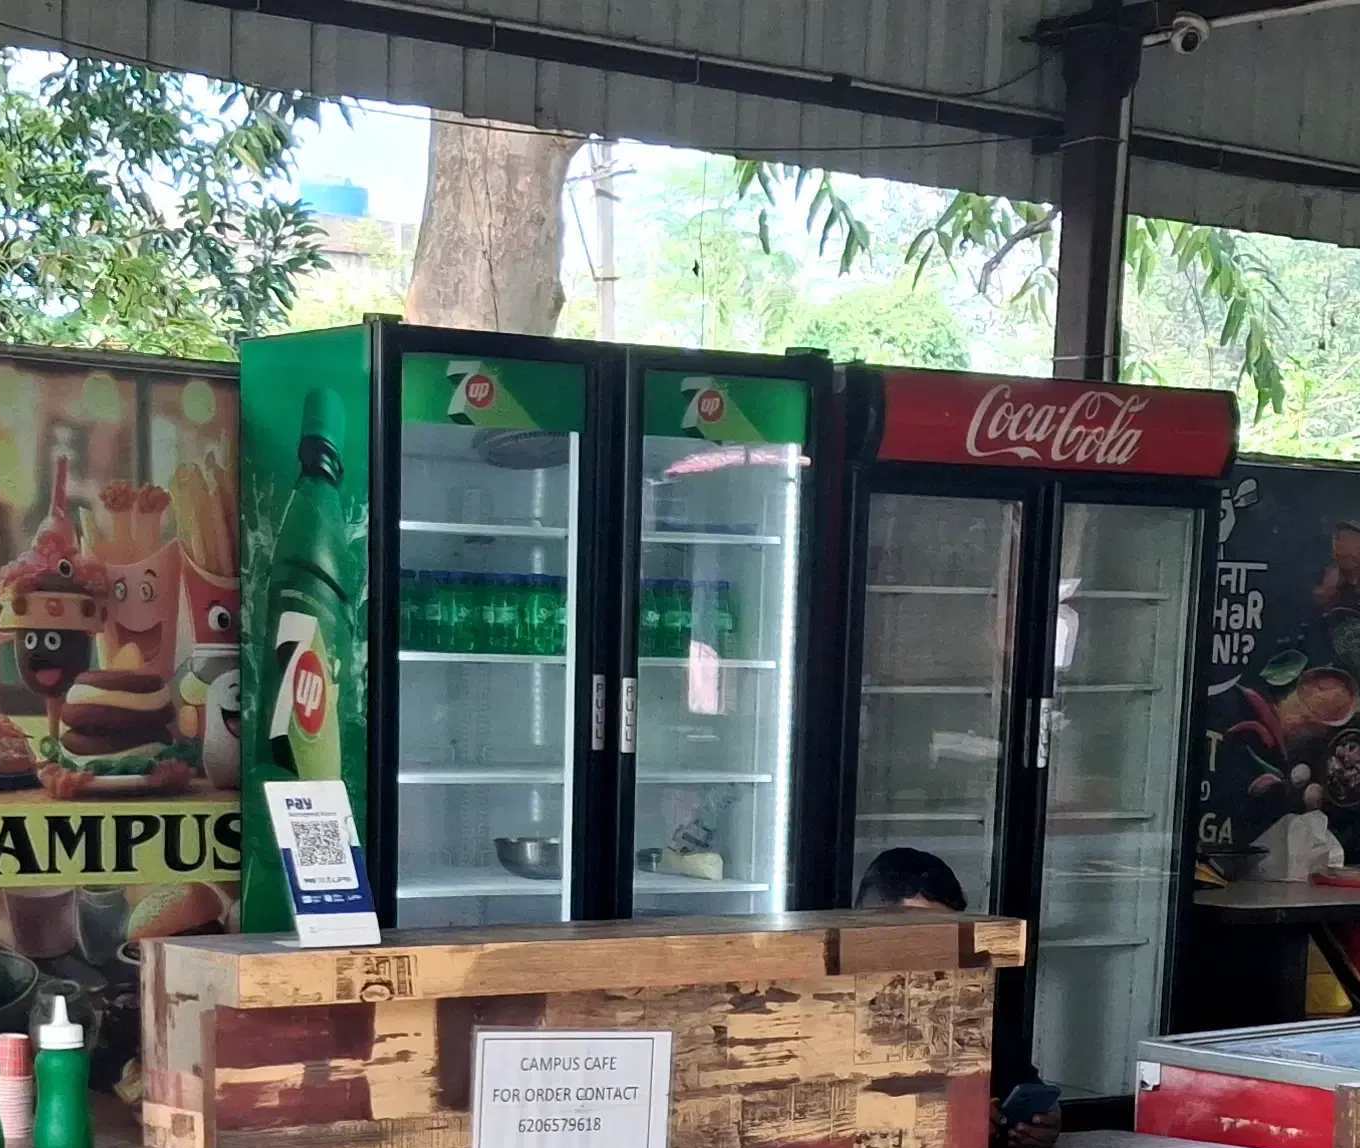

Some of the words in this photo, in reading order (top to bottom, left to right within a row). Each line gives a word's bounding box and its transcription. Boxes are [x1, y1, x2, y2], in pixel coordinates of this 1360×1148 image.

[966, 383, 1150, 465] Coca-Cola
[595, 682, 604, 740] PULL
[625, 685, 635, 742] PULL
[520, 1056, 581, 1072] CAMPUS
[583, 1056, 618, 1071] CAFE
[493, 1088, 520, 1103] FOR
[525, 1087, 572, 1102] ORDER
[576, 1086, 639, 1101] CONTACT
[518, 1117, 602, 1133] 6206579618
